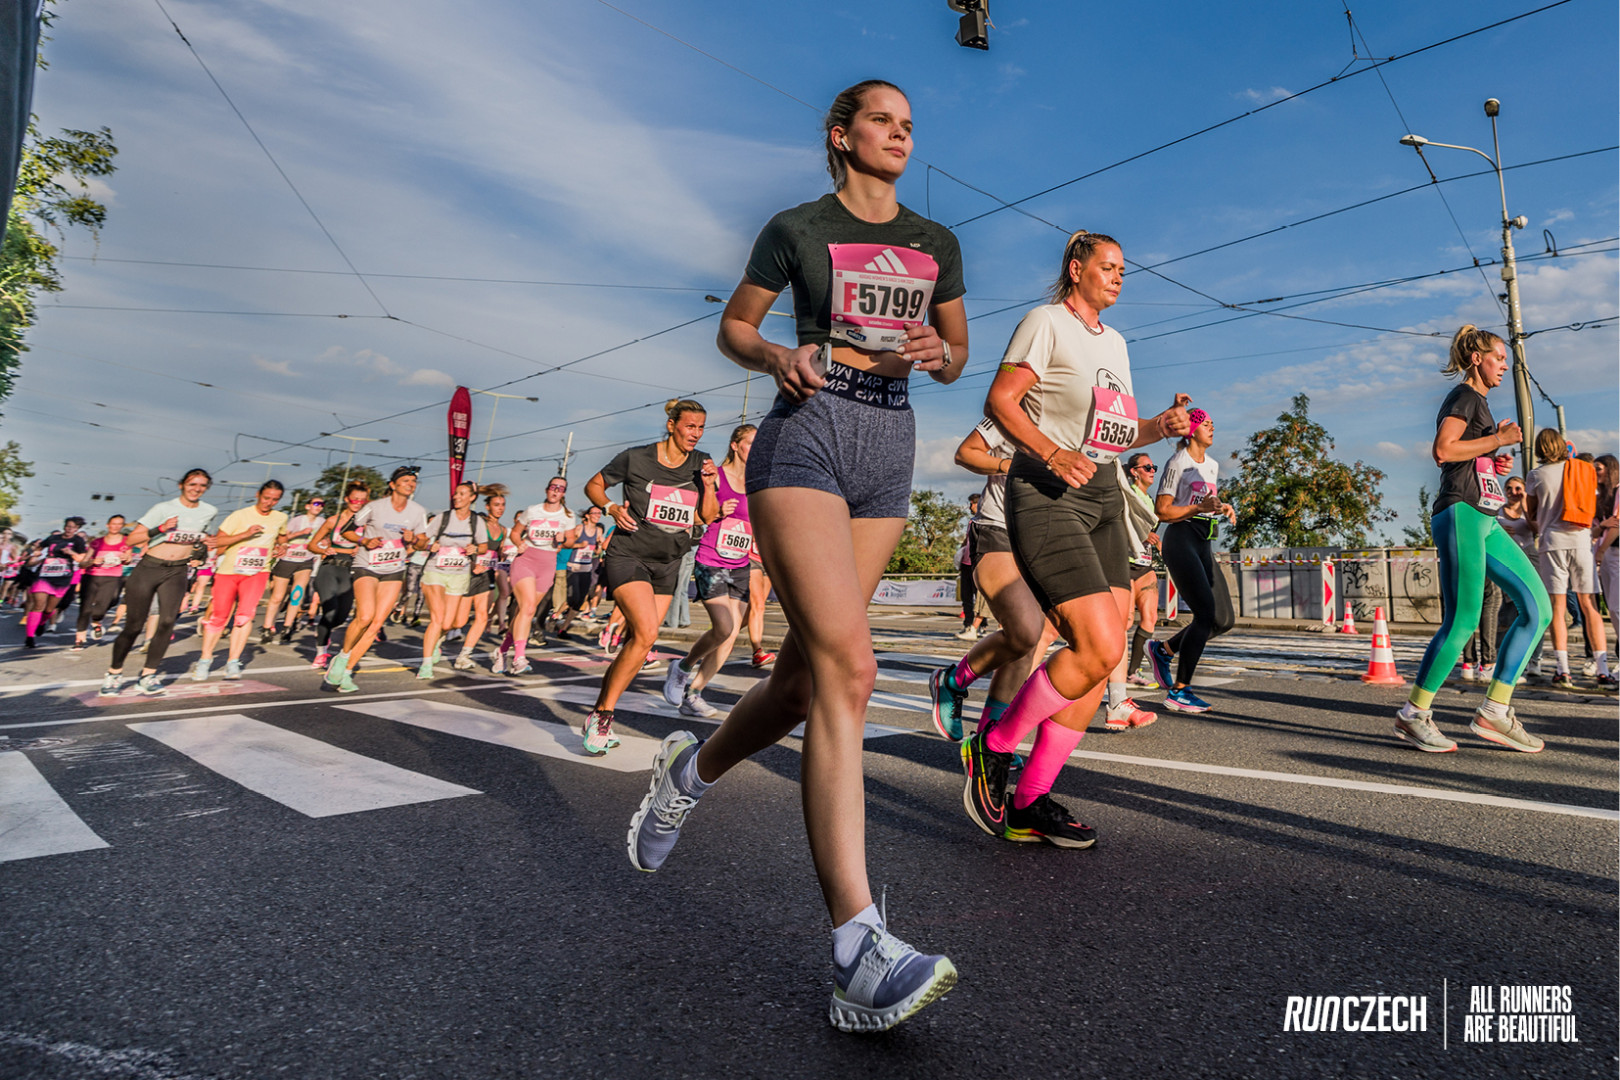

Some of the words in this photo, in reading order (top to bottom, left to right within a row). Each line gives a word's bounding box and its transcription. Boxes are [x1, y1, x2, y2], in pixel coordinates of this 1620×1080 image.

[843, 281, 925, 319] F5799
[1093, 418, 1135, 447] F5354
[652, 504, 690, 523] F5874
[721, 533, 750, 549] F5687
[372, 550, 401, 562] F5224
